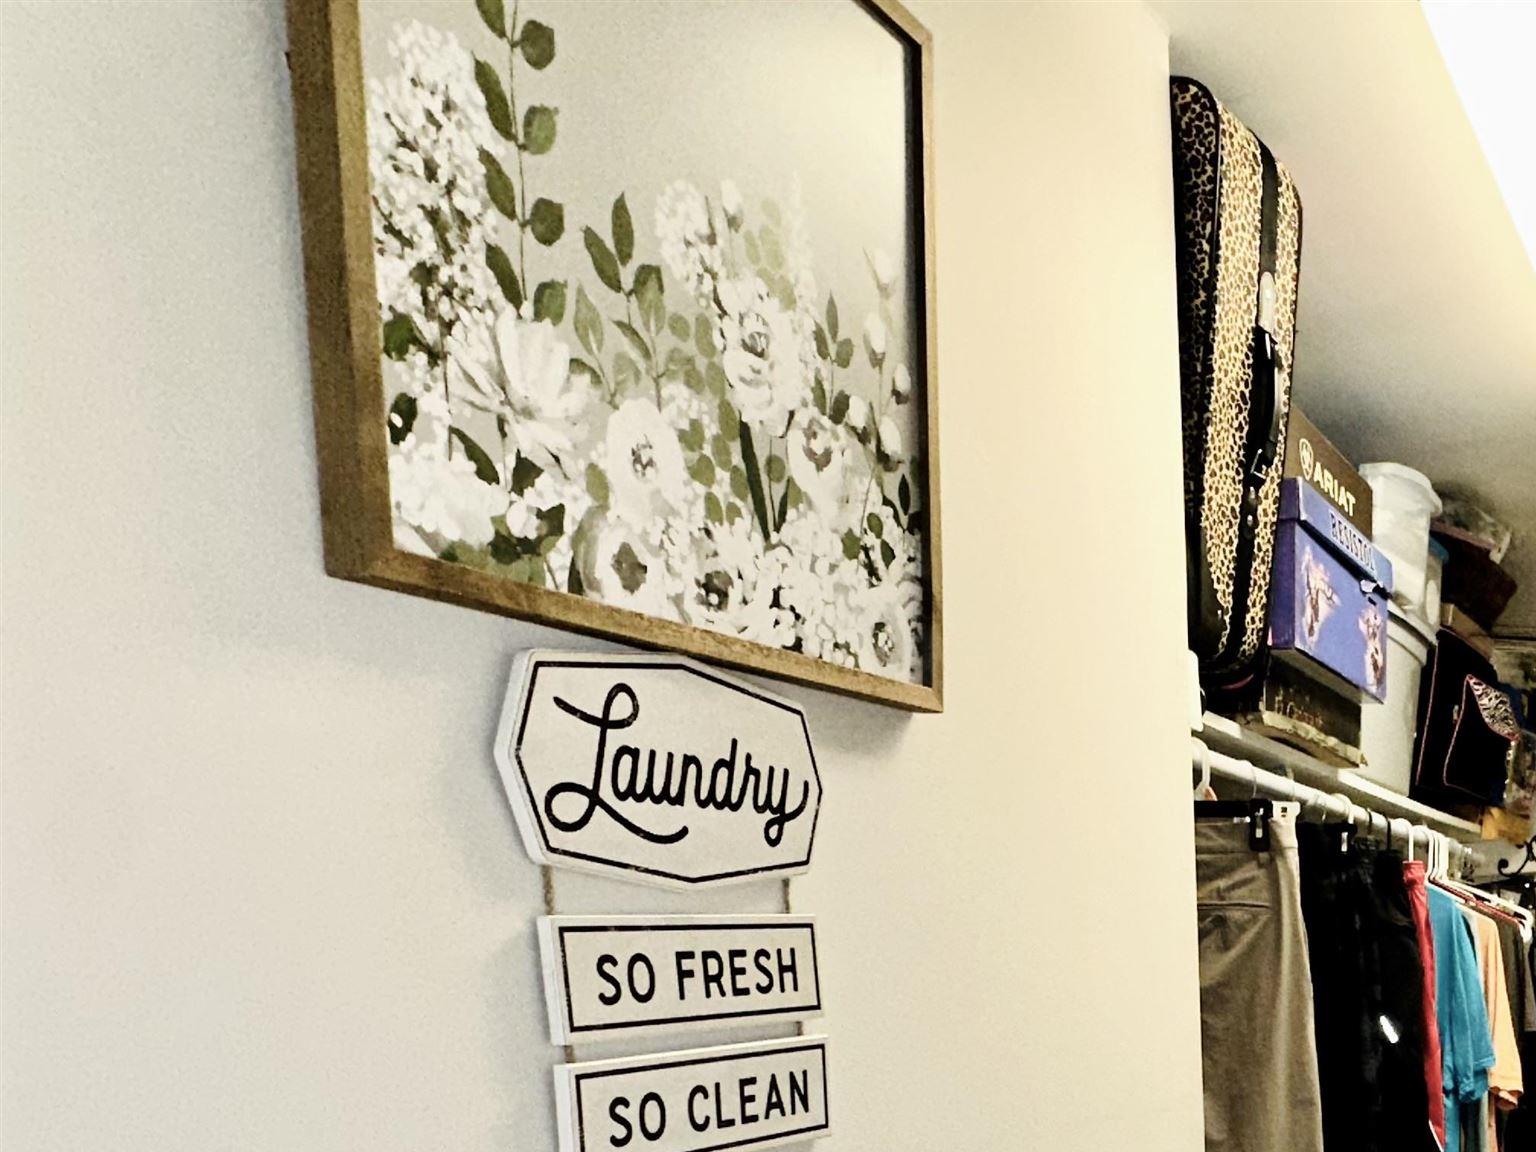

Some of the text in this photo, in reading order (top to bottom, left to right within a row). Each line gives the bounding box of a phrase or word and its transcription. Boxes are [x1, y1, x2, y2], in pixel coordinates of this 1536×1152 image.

[1313, 461, 1356, 517] ARIAT
[1329, 511, 1376, 572] RESISTOL
[545, 682, 809, 847] Laundry
[597, 947, 799, 1006] SO FRESH
[608, 1068, 810, 1148] SO CLEAN
